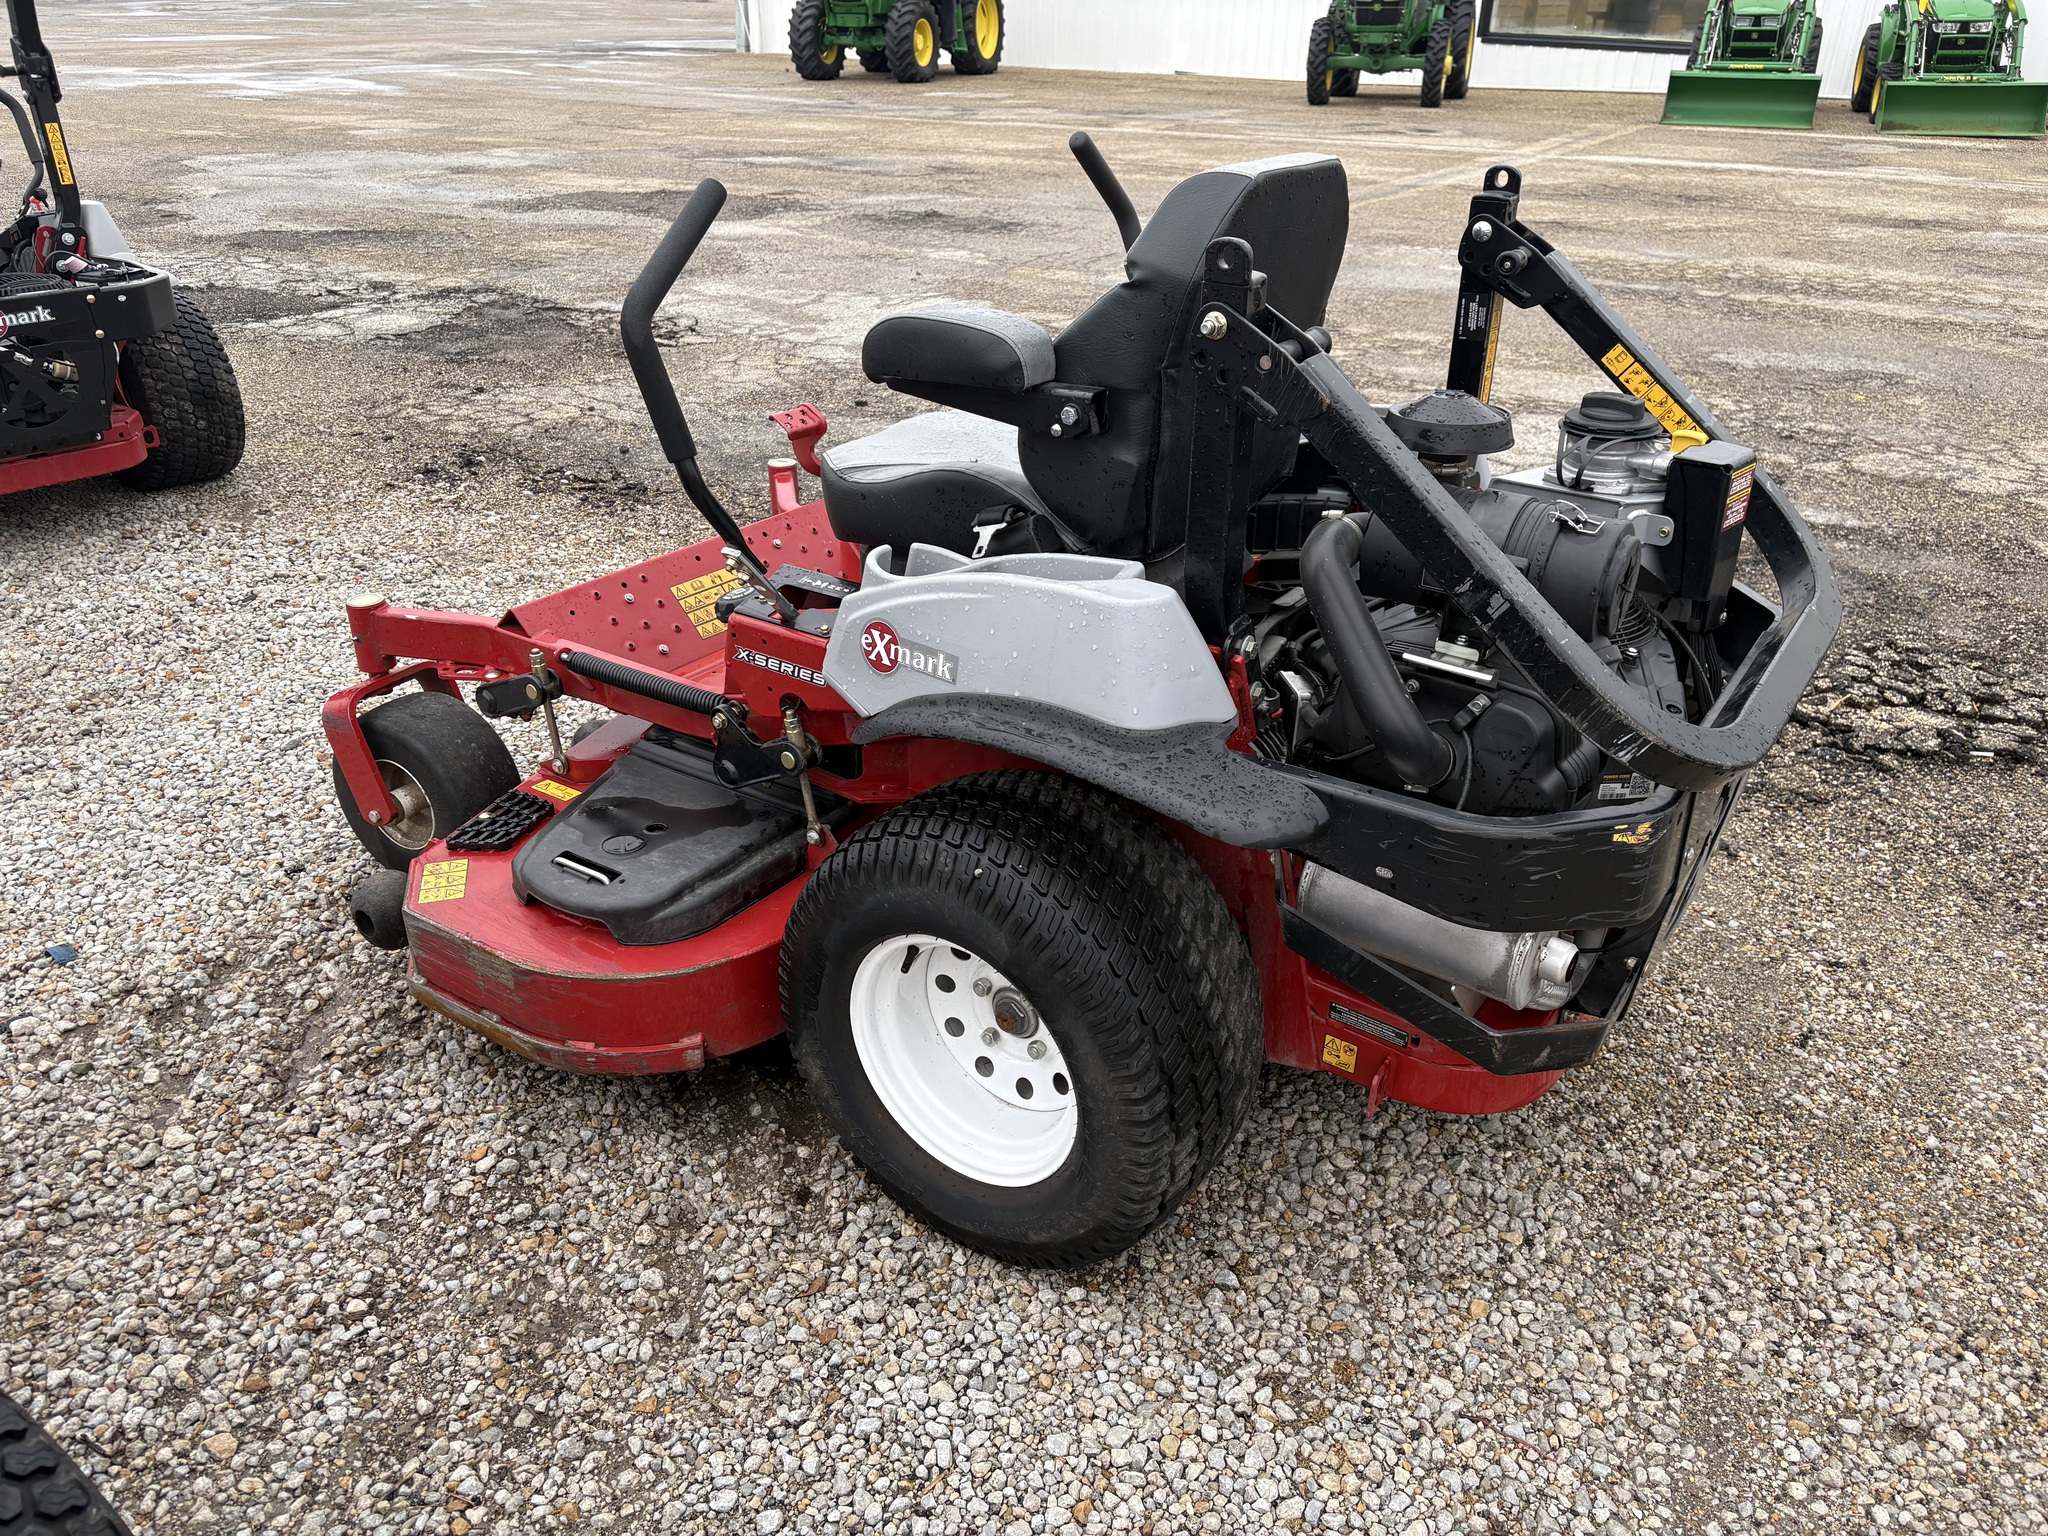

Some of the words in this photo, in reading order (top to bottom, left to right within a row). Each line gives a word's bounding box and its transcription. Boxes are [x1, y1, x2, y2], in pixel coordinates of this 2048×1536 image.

[0, 305, 52, 326] mark
[733, 646, 826, 687] X-SERIES
[861, 628, 954, 681] eXmark
